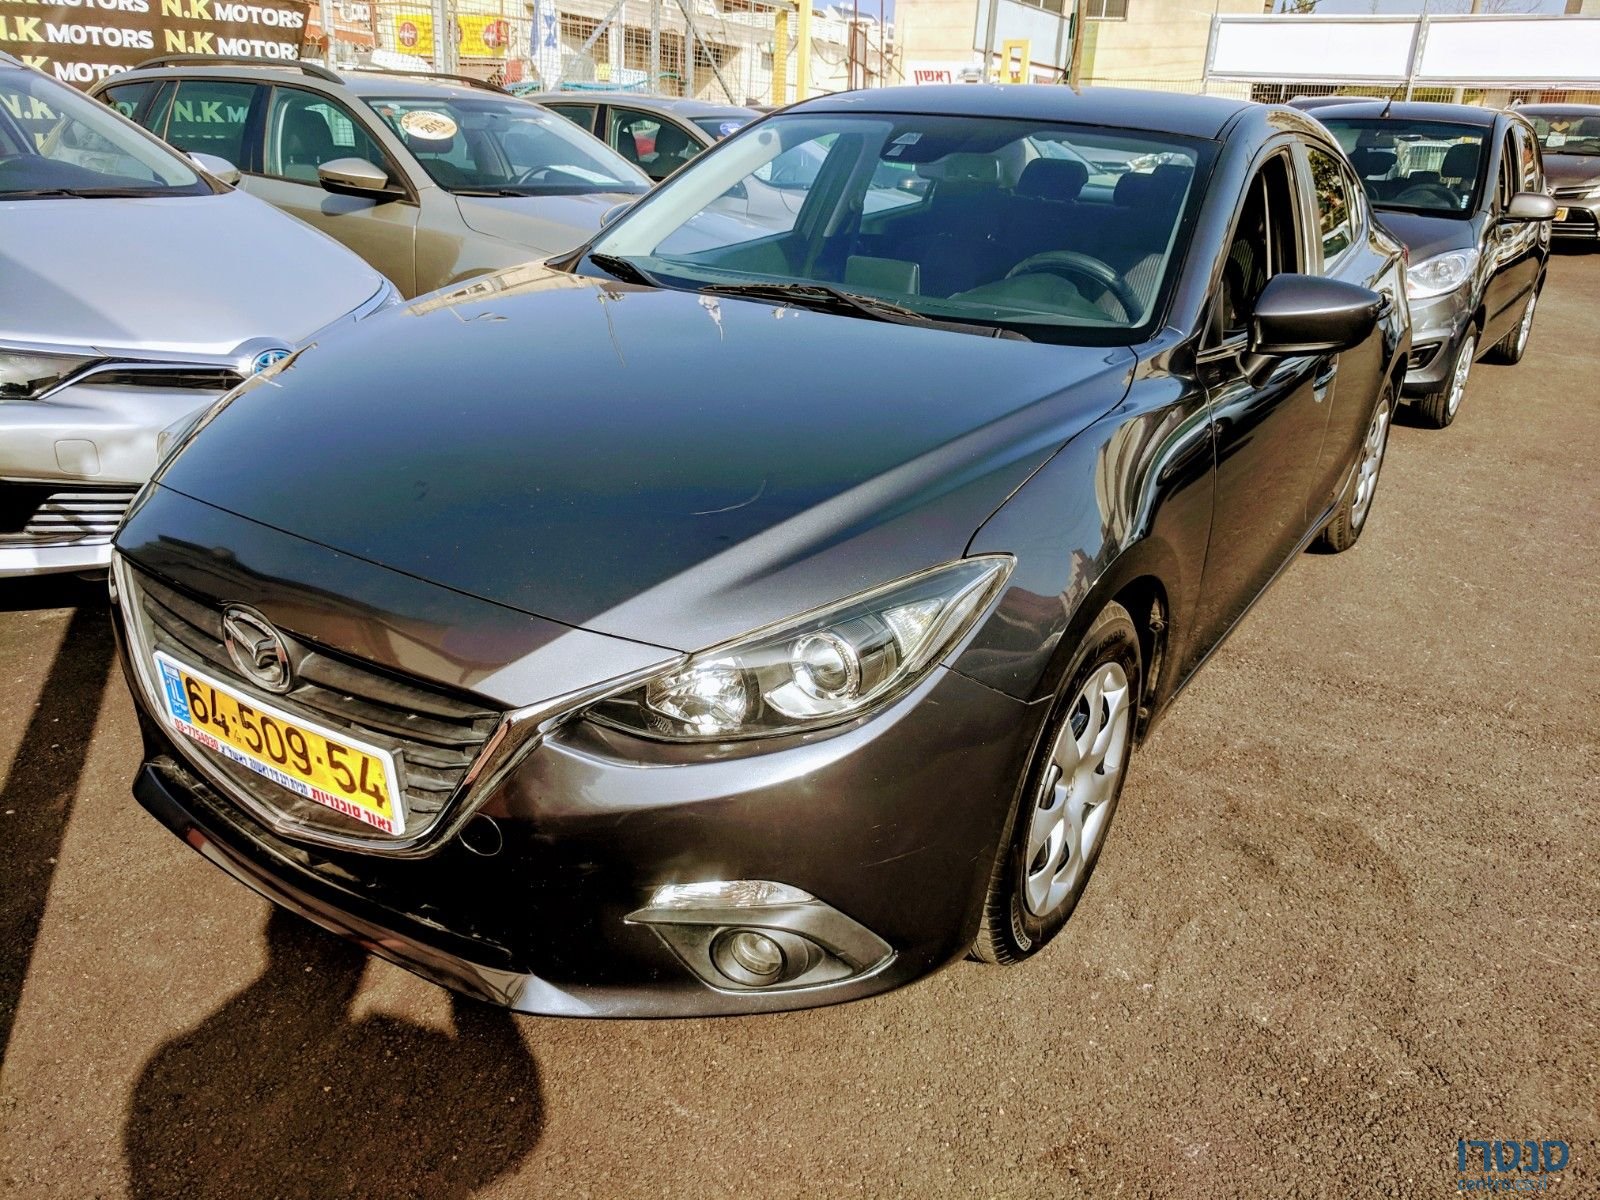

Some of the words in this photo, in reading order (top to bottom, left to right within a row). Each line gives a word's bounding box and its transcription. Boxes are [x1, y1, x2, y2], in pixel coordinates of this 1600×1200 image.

[162, 0, 212, 20] N.K
[213, 2, 304, 29] MOTORS
[45, 23, 155, 49] MOTORS
[163, 29, 218, 55] N.K
[914, 69, 951, 85] ראשון
[174, 100, 225, 123] N.K
[311, 787, 361, 818] סוכנויות
[364, 809, 393, 833] נאור
